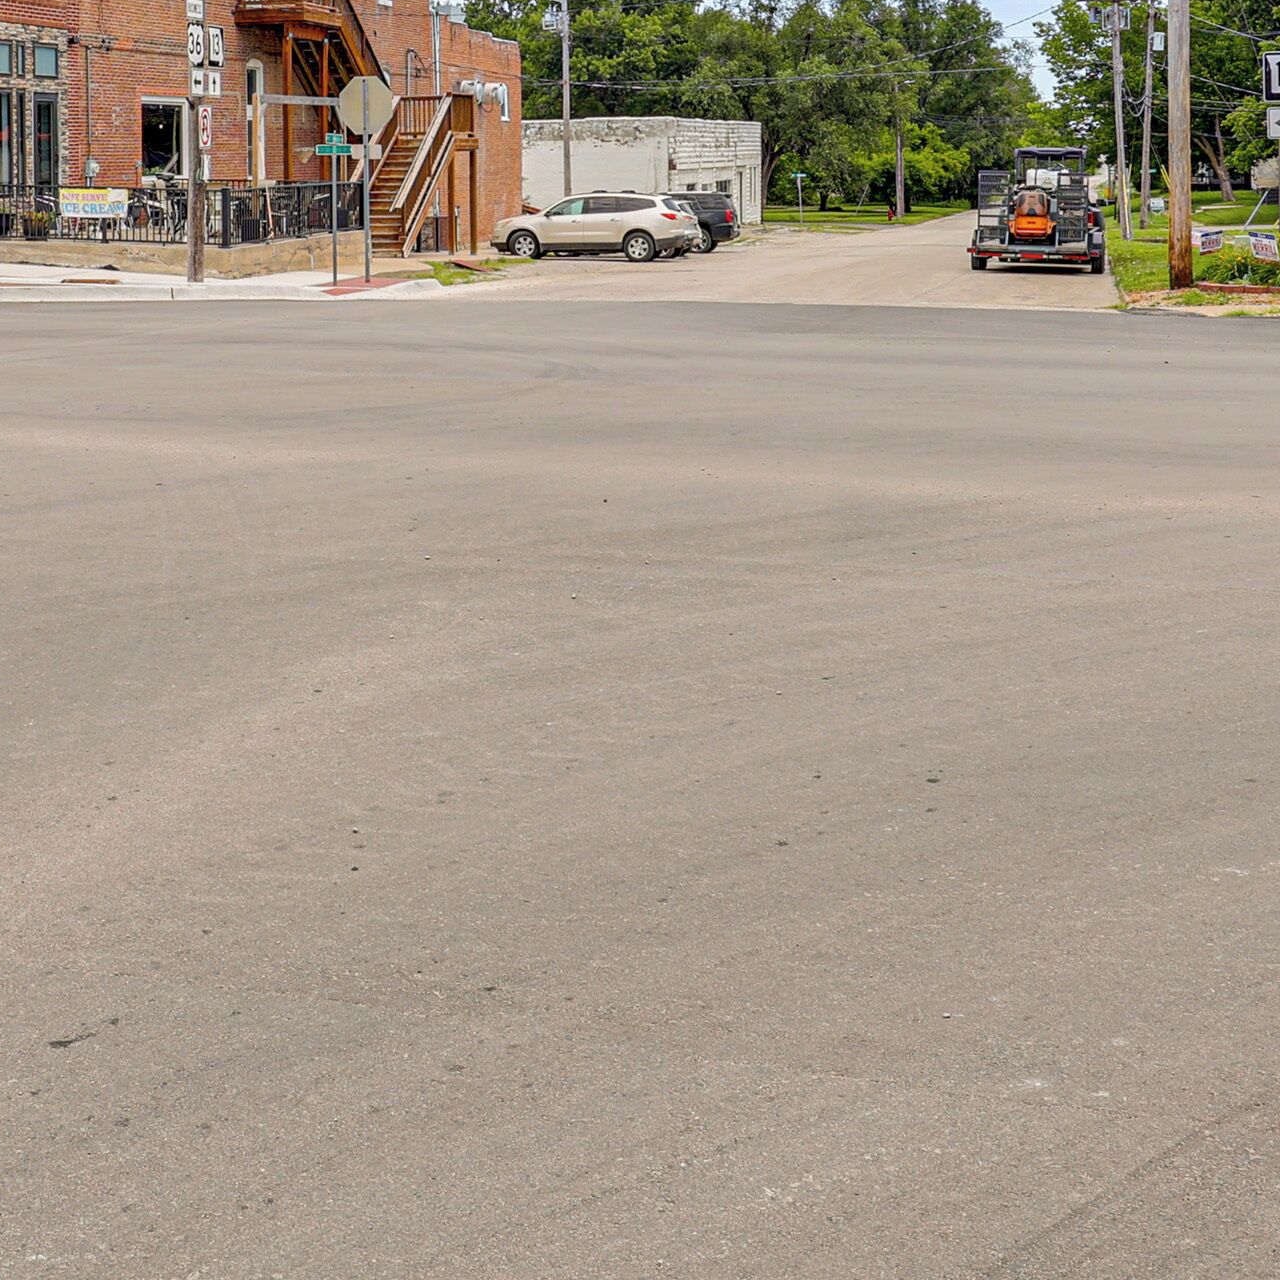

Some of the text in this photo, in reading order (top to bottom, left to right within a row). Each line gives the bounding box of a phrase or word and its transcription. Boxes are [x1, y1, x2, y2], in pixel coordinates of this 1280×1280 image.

[189, 32, 202, 55] 36
[212, 33, 220, 55] 13
[81, 193, 108, 202] SERVE
[82, 202, 126, 215] CREAM
